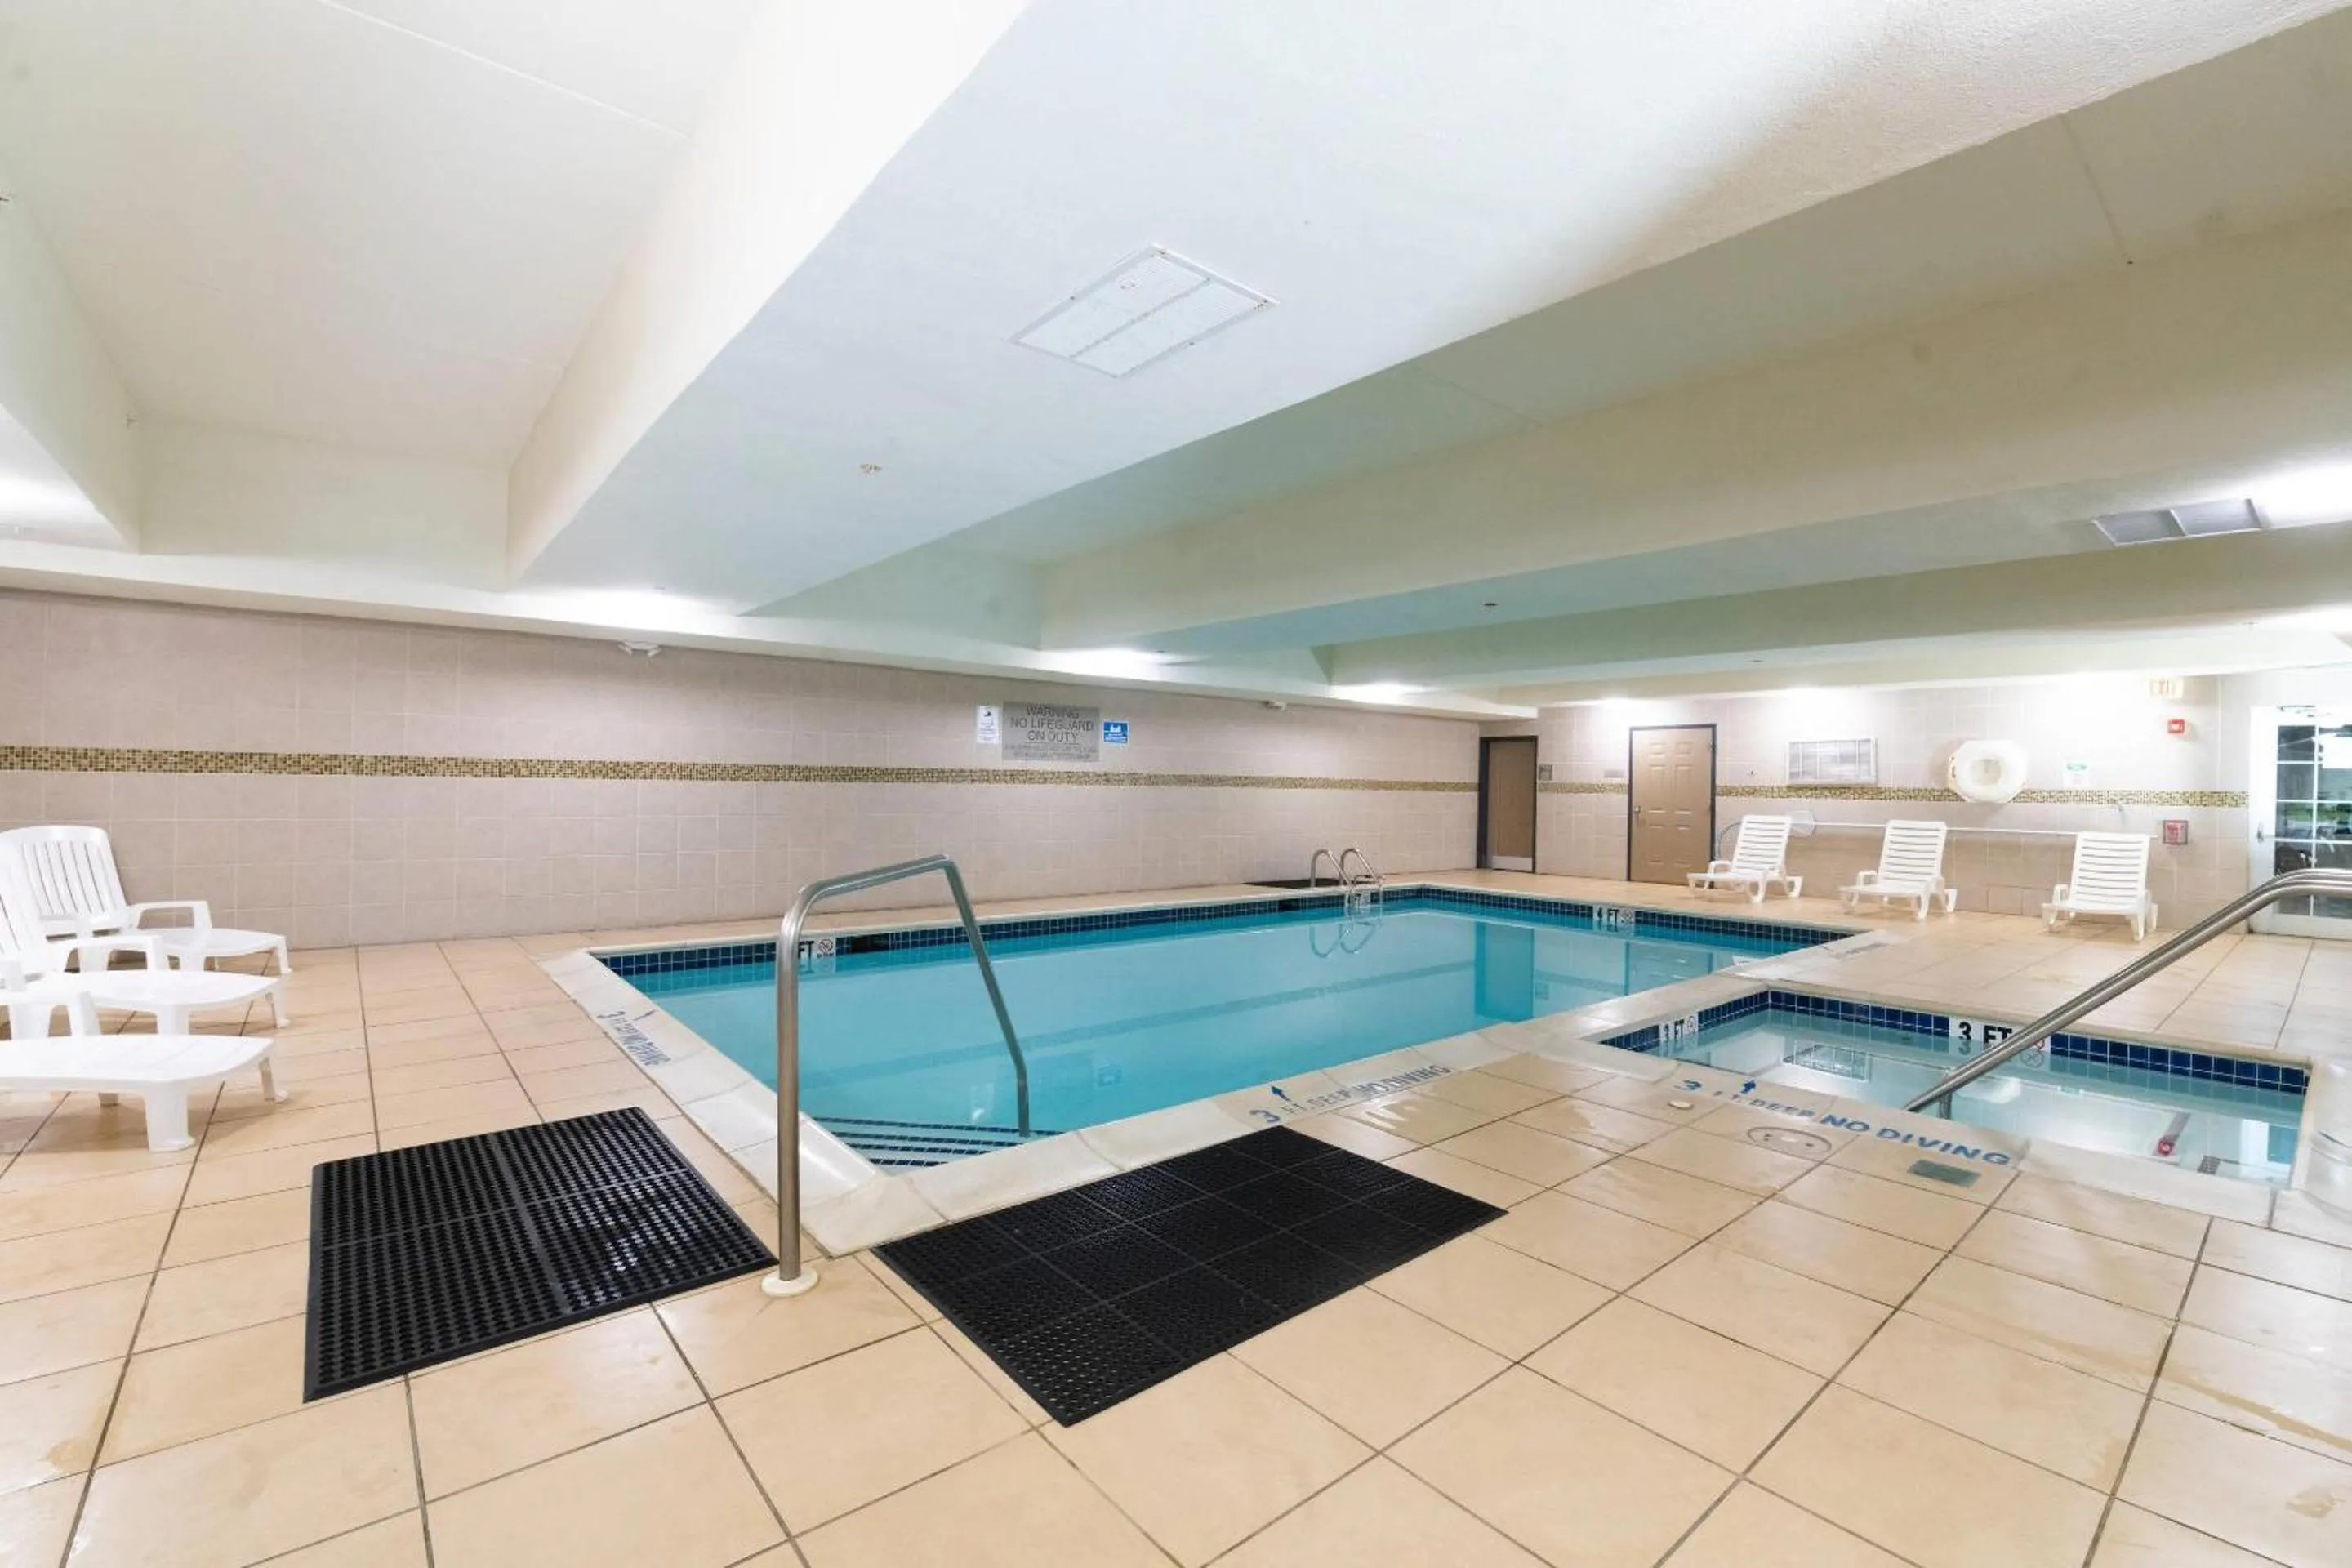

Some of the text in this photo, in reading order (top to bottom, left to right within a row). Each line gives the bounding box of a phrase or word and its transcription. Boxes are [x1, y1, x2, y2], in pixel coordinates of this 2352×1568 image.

[1010, 718, 1028, 728] NO
[1028, 730, 1045, 741] ON
[1958, 1021, 1971, 1041] 3
[1249, 1108, 1281, 1124] 3
[1819, 1114, 1871, 1133] NO
[1878, 1129, 2010, 1166] DIVING
